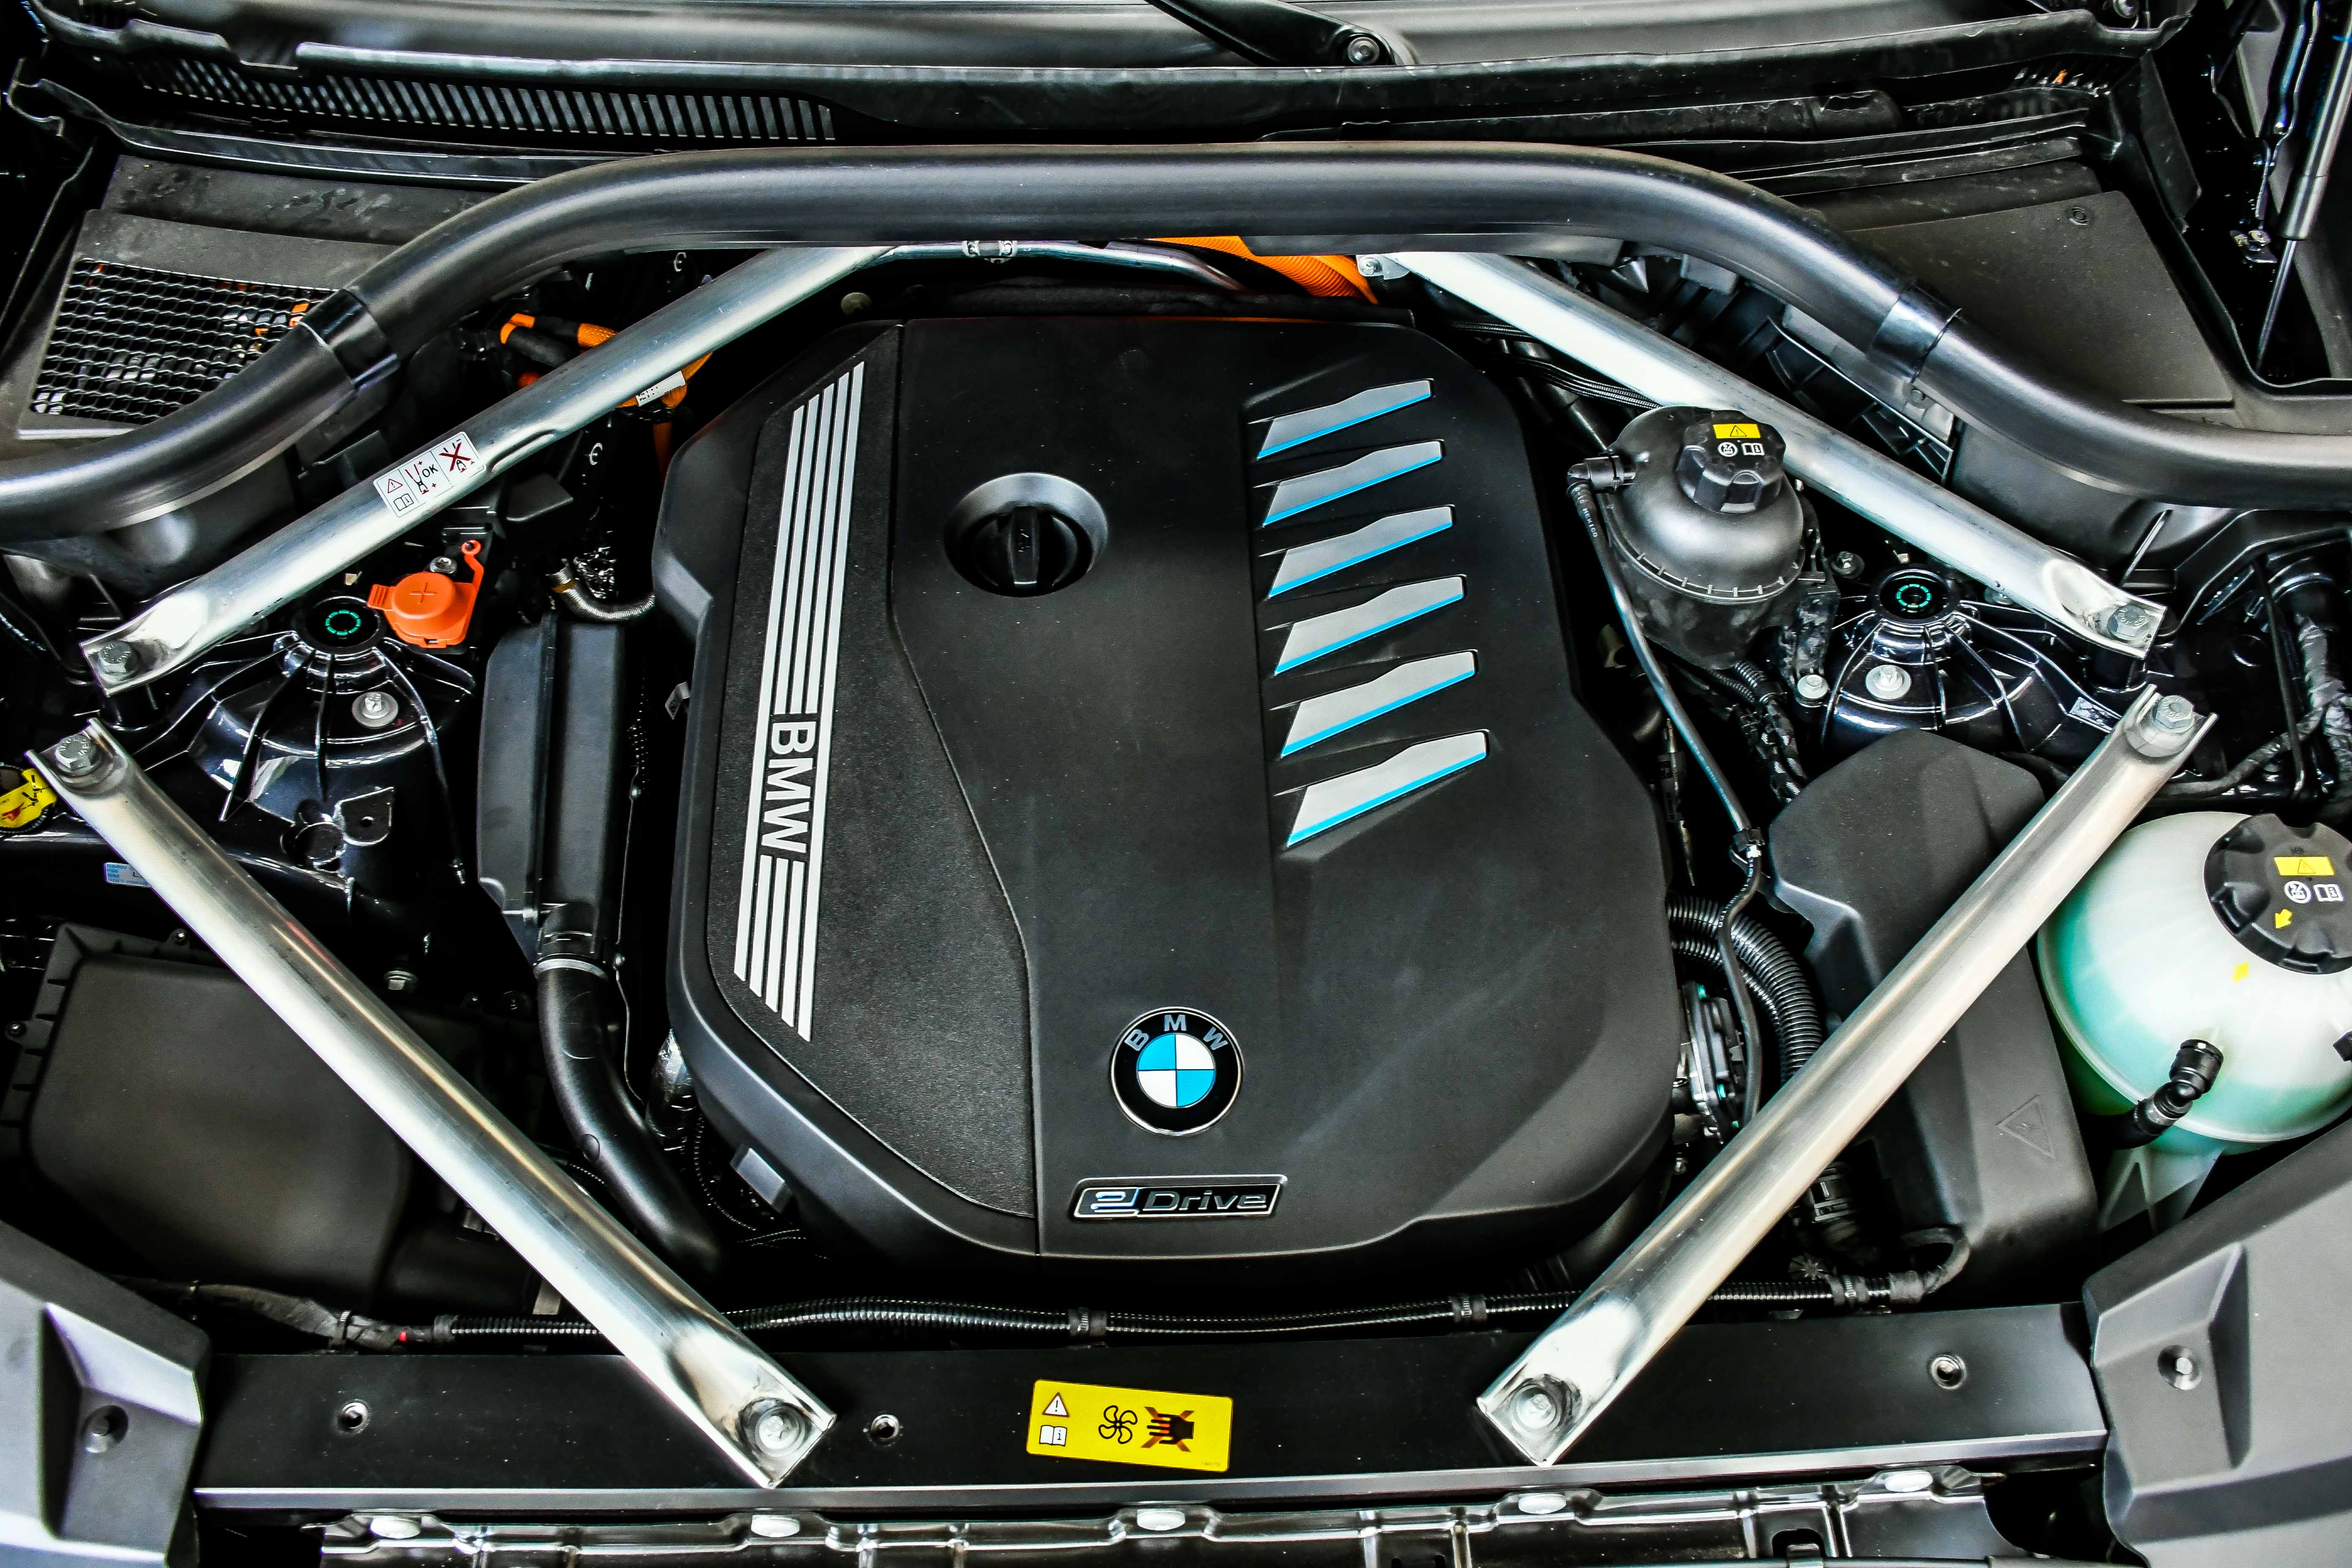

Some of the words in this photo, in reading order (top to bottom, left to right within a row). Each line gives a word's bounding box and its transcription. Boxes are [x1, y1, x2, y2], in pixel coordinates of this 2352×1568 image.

[422, 464, 438, 477] OK
[761, 721, 817, 853] BMW
[1124, 1015, 1228, 1051] BMW
